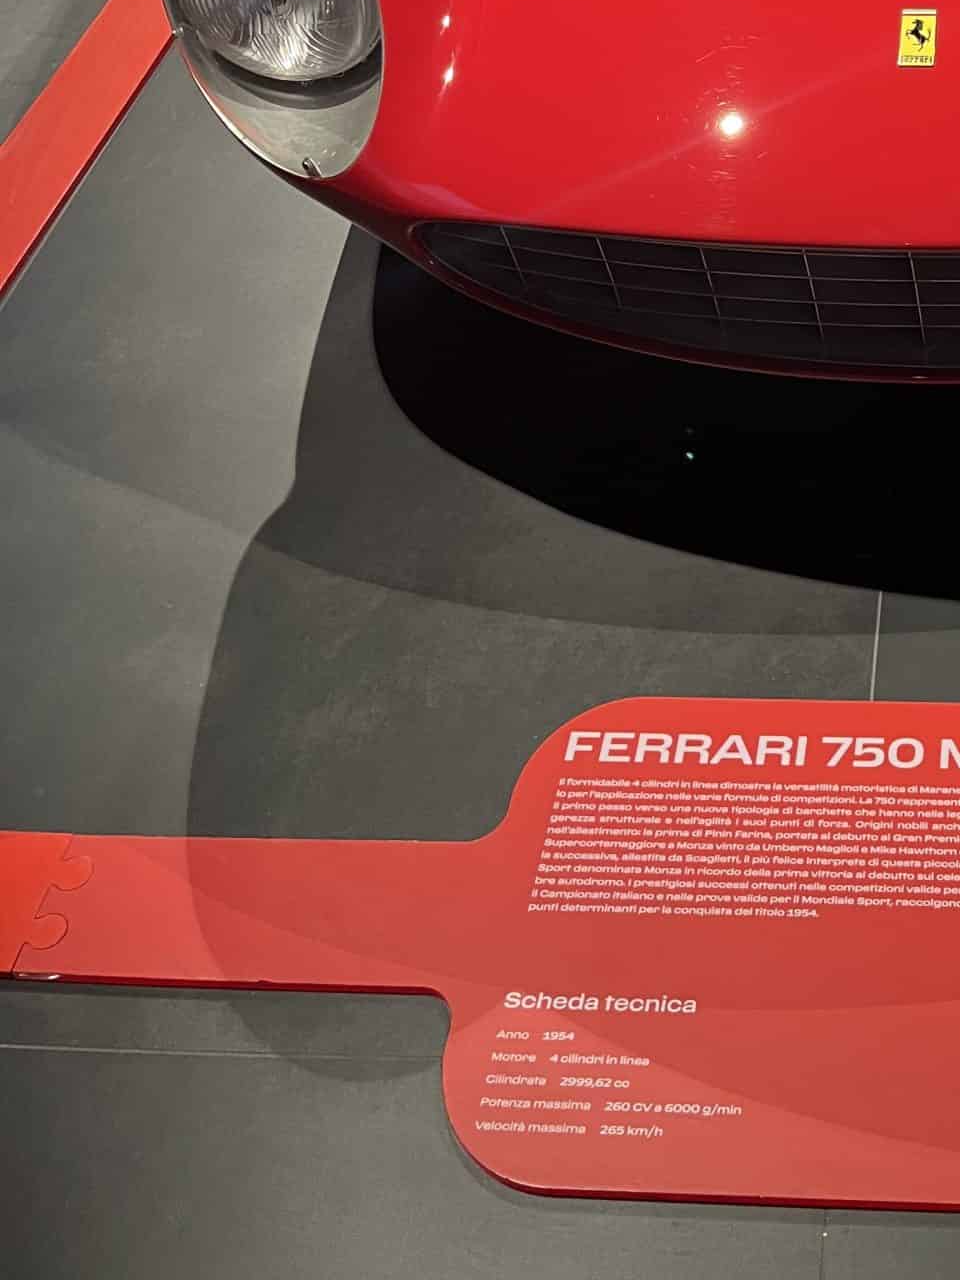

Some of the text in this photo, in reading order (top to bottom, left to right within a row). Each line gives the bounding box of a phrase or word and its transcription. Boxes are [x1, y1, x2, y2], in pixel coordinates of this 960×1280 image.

[563, 731, 807, 767] FERRARI
[822, 737, 925, 768] 750
[566, 777, 631, 787] formidabile
[640, 780, 680, 788] cilindri
[691, 780, 719, 789] linea
[719, 781, 771, 790] dimostra
[783, 783, 840, 792] versatilità
[840, 784, 906, 793] motoristica
[560, 802, 596, 811] primo
[597, 803, 633, 812] passo
[692, 806, 729, 814] nuova
[730, 805, 780, 816] tipologia
[795, 806, 852, 816] barchette
[854, 808, 877, 817] che
[878, 808, 916, 817] hanno
[916, 809, 945, 818] nella
[550, 814, 596, 824] gerezza
[599, 815, 662, 824] strutturale
[675, 816, 732, 827] nell'agilità
[742, 818, 767, 826] suoi
[769, 818, 800, 828] punti
[854, 820, 894, 830] Origini
[896, 821, 929, 830] nobili
[534, 876, 556, 885] bre
[632, 879, 696, 889] prestigiosi
[697, 881, 750, 889] successi
[750, 881, 798, 890] ottenuti
[798, 882, 827, 891] nelle
[828, 884, 905, 893] competizioni
[906, 884, 942, 894] valide
[527, 903, 559, 912] punti
[560, 903, 637, 913] determinanti
[638, 906, 660, 914] per
[673, 906, 733, 916] conquista
[733, 907, 753, 916] del
[754, 907, 786, 917] titolo
[504, 992, 696, 1014] Scheda tecnica
[496, 1030, 574, 1040] Anno 1954
[492, 1052, 649, 1066] Motore 4 cilindri in linea
[486, 1075, 546, 1085] Cilindrata
[480, 1097, 530, 1109] Potenza
[534, 1100, 590, 1110] massima
[604, 1102, 630, 1112] 260
[633, 1103, 652, 1112] CV
[665, 1104, 701, 1114] 6000
[703, 1104, 741, 1116] g/min
[476, 1120, 663, 1138] Velocità massima 265 km/h
